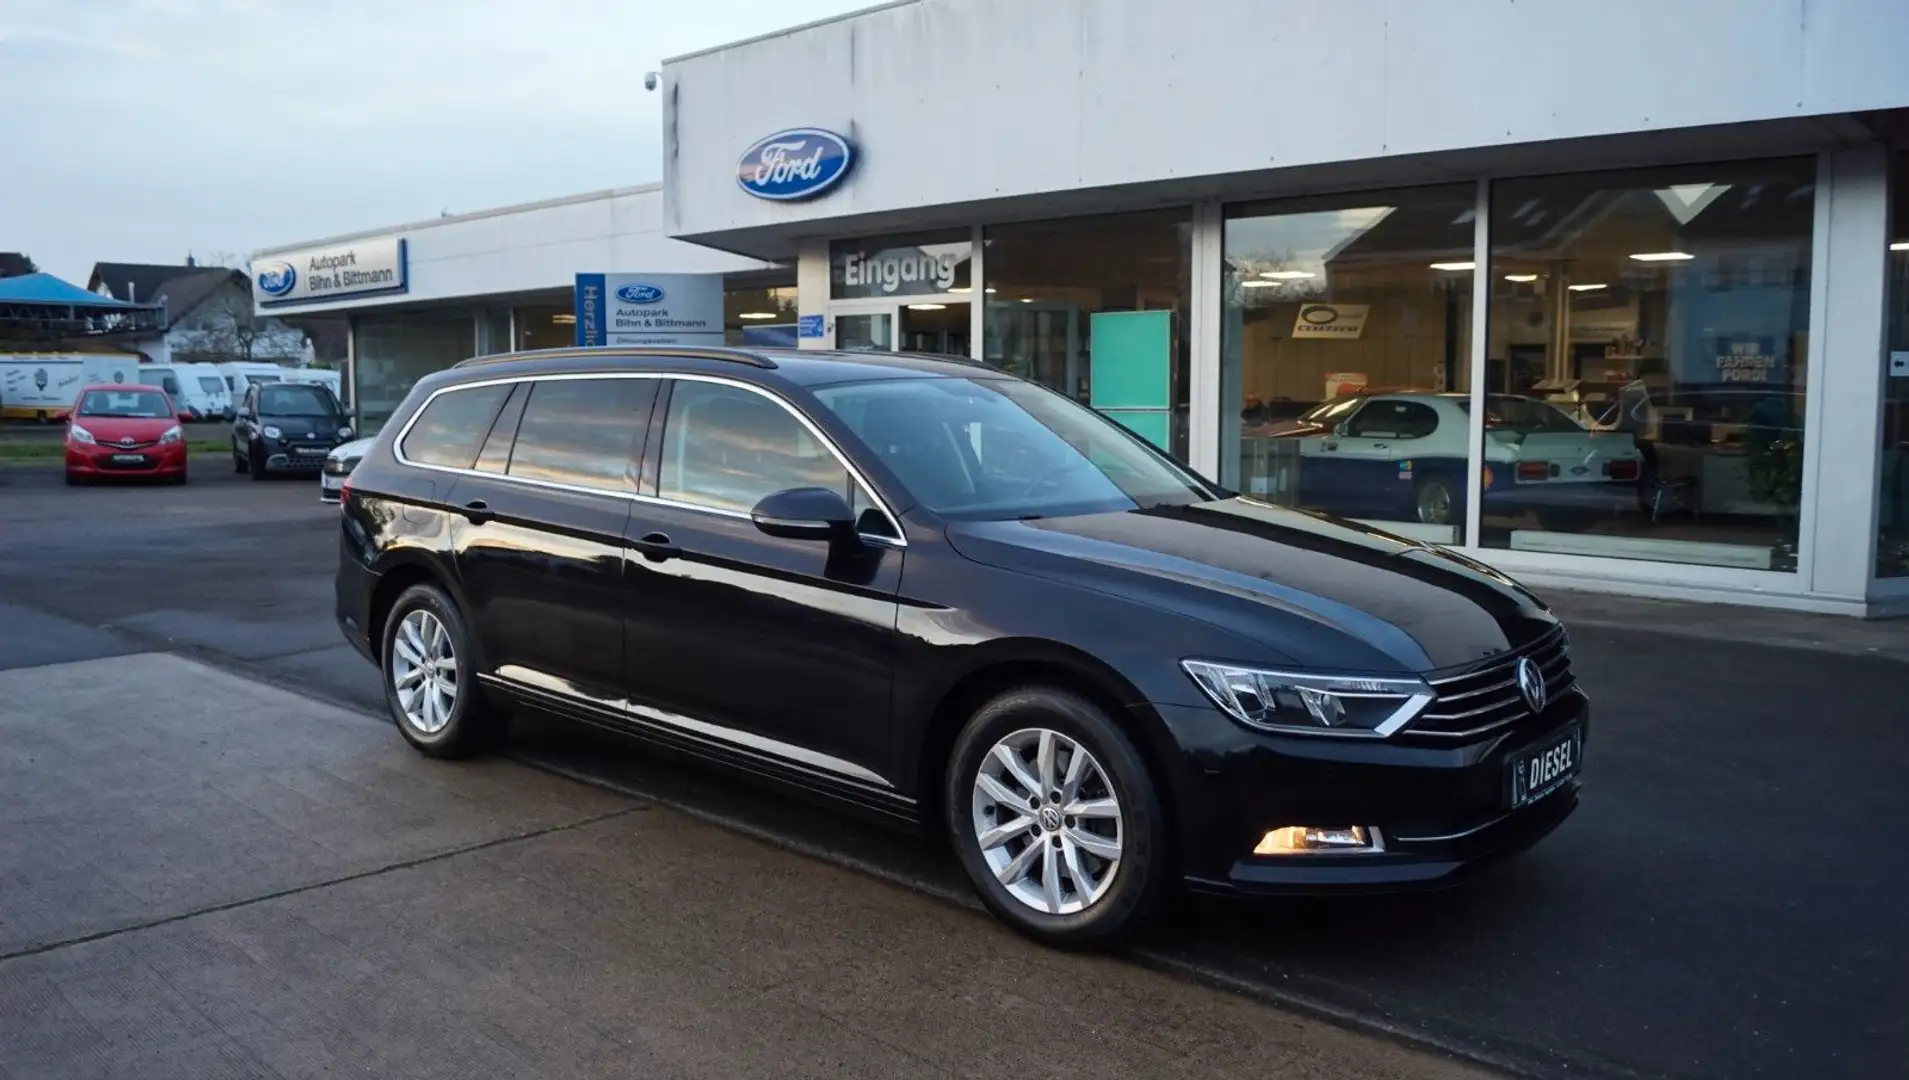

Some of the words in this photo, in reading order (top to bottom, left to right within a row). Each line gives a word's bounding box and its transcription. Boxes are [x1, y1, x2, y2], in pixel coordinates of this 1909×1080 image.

[755, 140, 823, 186] Ford
[309, 251, 356, 271] Autopark
[845, 250, 955, 292] Eingang
[309, 274, 332, 291] Bihn
[334, 274, 341, 288] &
[343, 269, 393, 287] Bittmann
[625, 285, 657, 299] Ford
[616, 308, 669, 317] Autopark
[616, 319, 641, 327] Bihn
[644, 319, 652, 327] &
[655, 319, 706, 327] Bittmann
[1530, 740, 1572, 789] DIESEL
